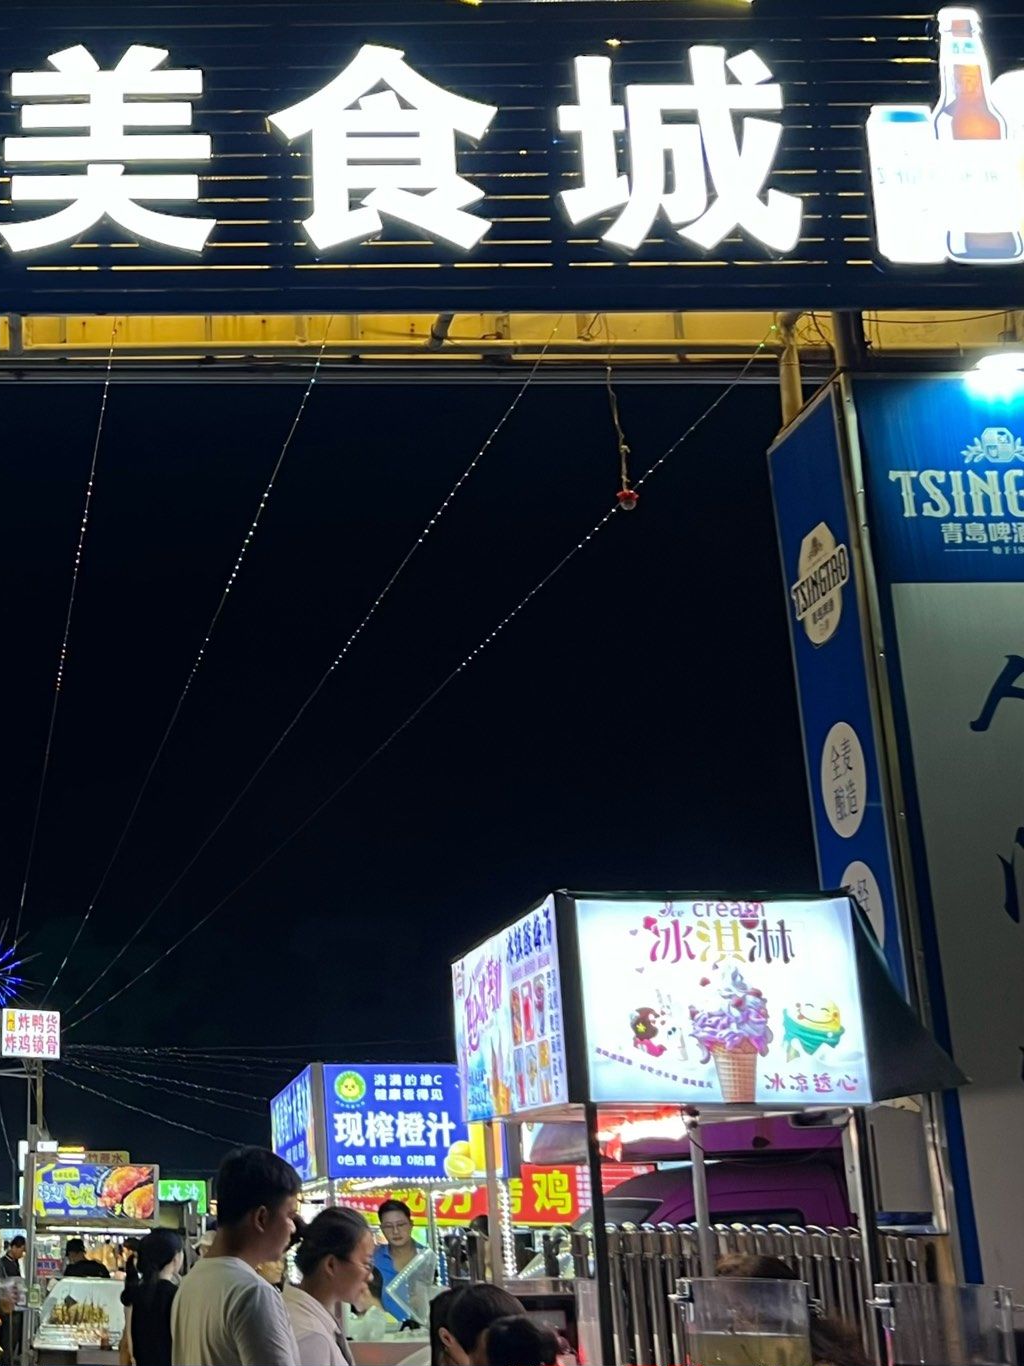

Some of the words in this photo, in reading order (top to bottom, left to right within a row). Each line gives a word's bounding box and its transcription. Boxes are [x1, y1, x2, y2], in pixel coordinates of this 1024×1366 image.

[643, 916, 795, 964] 冰淇淋
[18, 1013, 58, 1034] 炸鸭货
[5, 1034, 58, 1055] 炸鸡锁骨
[764, 1073, 859, 1093] 冰凉透心
[333, 1111, 456, 1148] 现榨橙汁
